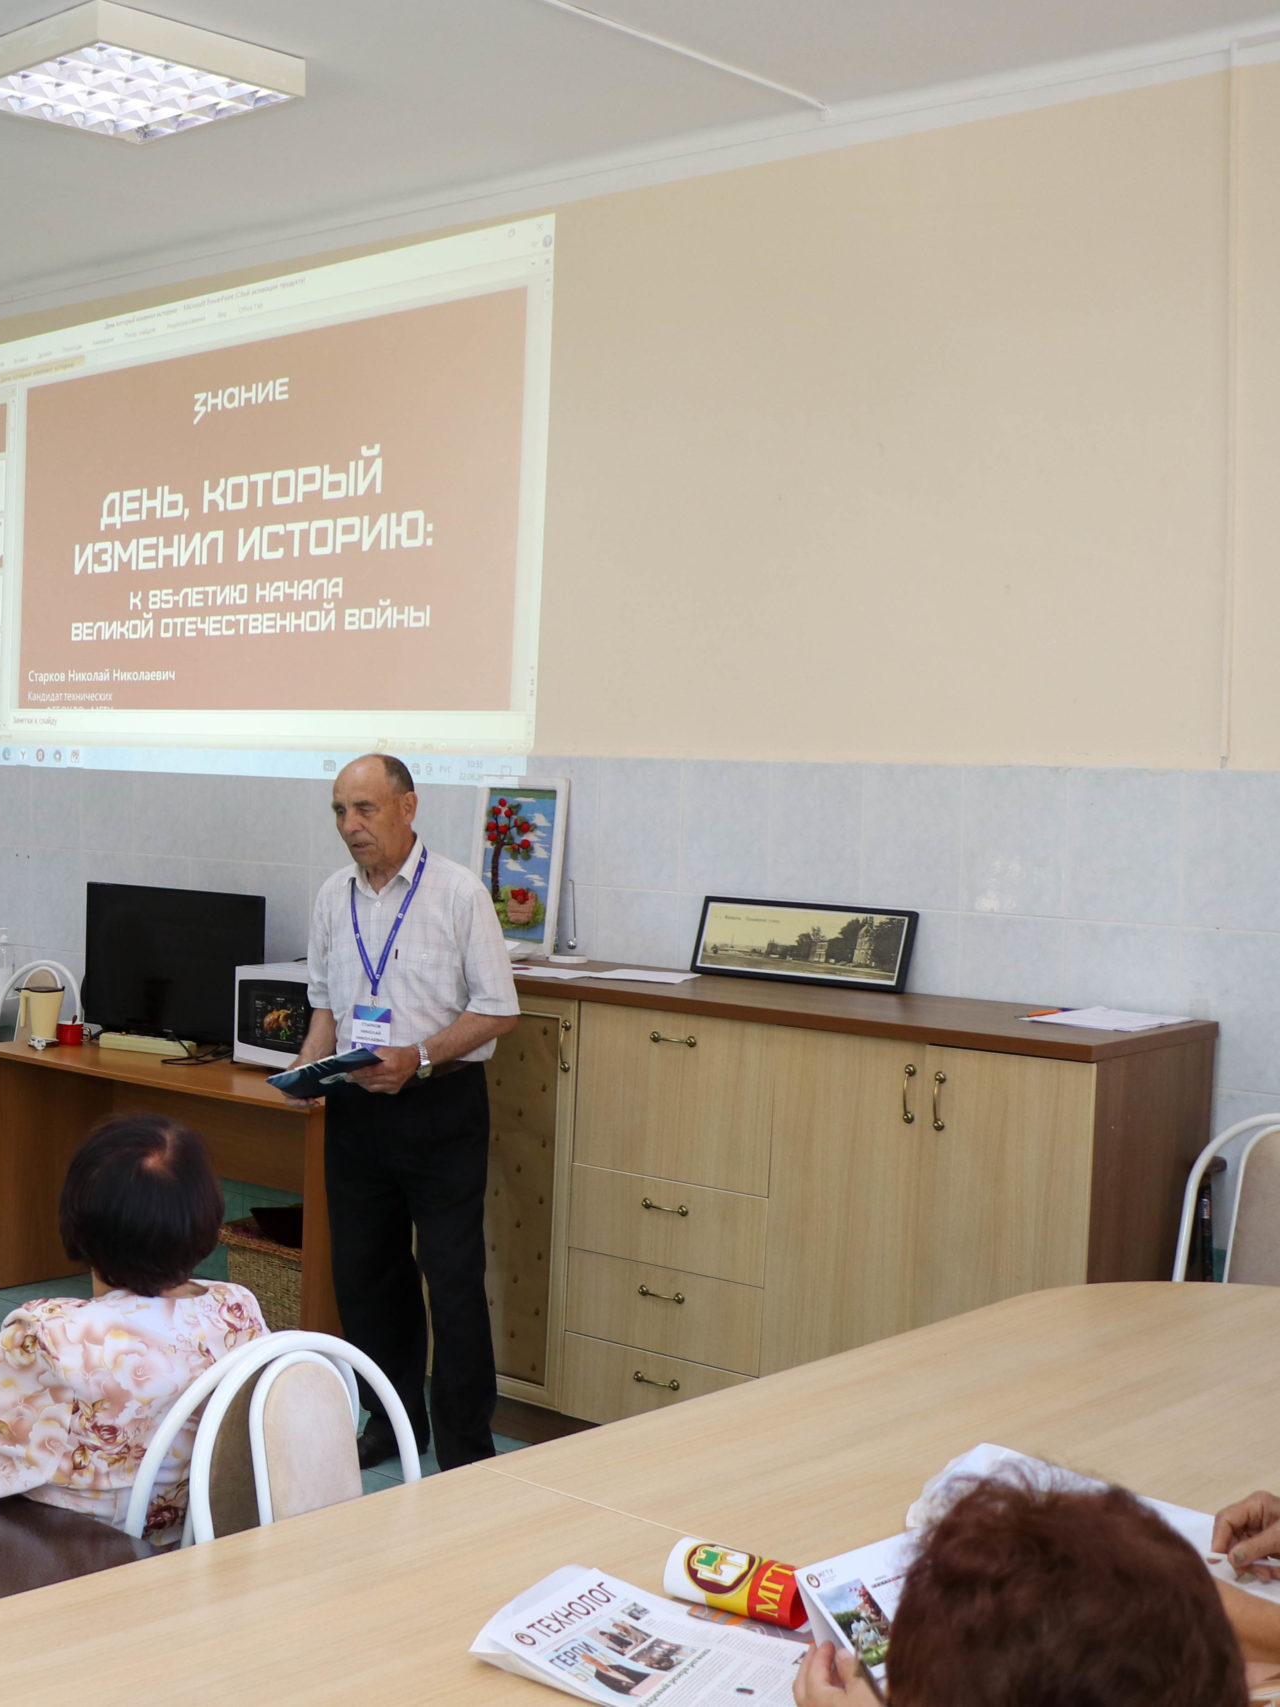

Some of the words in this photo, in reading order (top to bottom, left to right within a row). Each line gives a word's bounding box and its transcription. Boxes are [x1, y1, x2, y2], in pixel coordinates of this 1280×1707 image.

[100, 490, 190, 531] ДЕНЬ,
[203, 445, 383, 513] КОТОРЫЙ
[74, 529, 224, 576] ИЗМЕНИЛ
[237, 510, 435, 563] ИСТОРИЮ:
[129, 591, 142, 611] К
[148, 583, 248, 610] 85-ЛЕТИЮ
[256, 577, 343, 605] НАЧАЛА
[71, 612, 154, 643] ВЕЛИКОЙ
[160, 603, 336, 638] ОТЕЧЕСТВЕННОЙ
[344, 599, 431, 630] ВОЙНЫ
[28, 668, 65, 684] Старков
[68, 667, 110, 682] Николай
[112, 668, 176, 682] Николаевич
[27, 690, 63, 704] Кандидат
[525, 1581, 619, 1639] ТЕХНОЛОГ
[548, 1640, 599, 1672] ГЕРОИ
